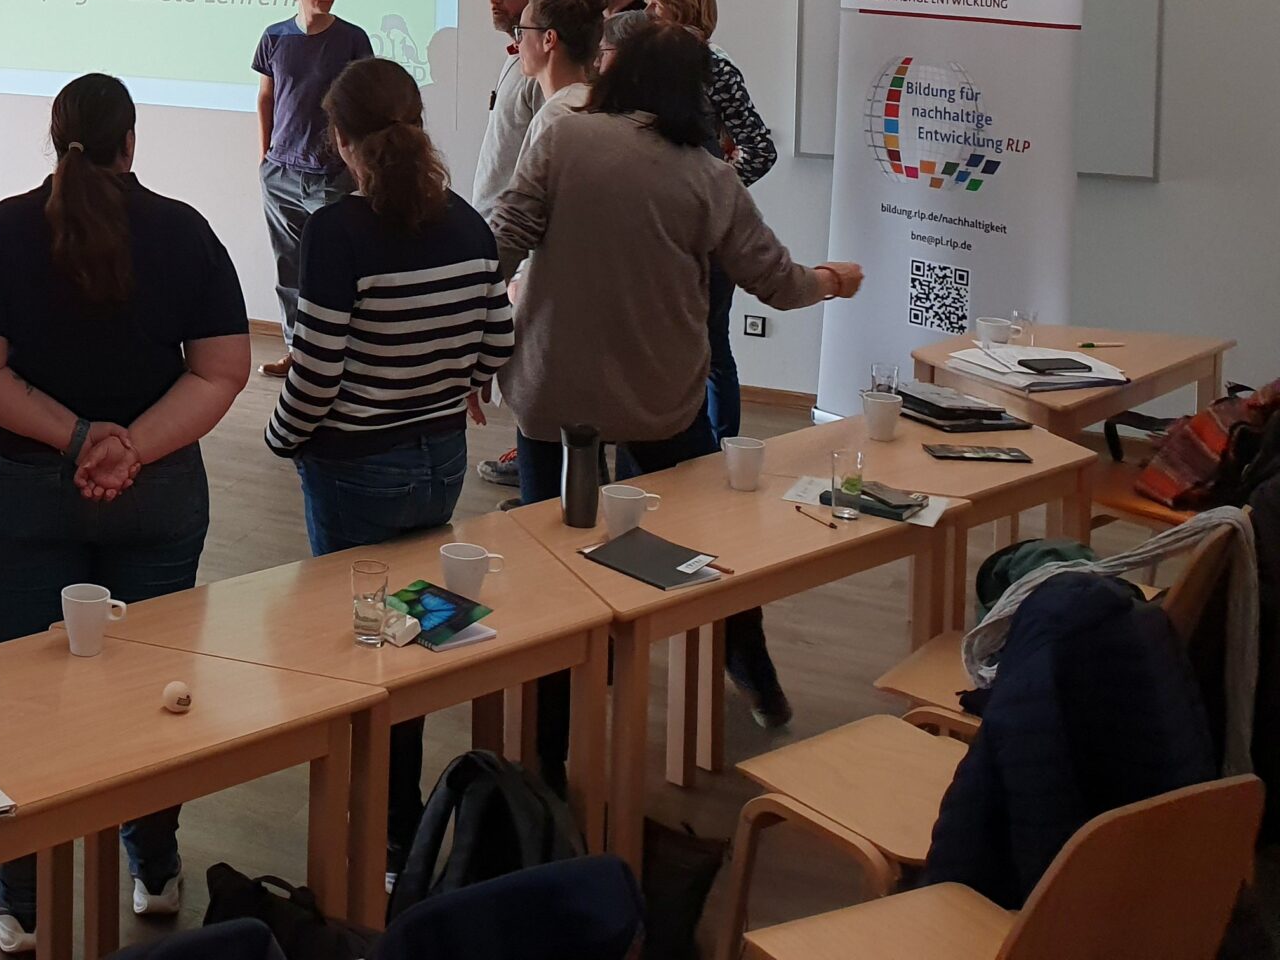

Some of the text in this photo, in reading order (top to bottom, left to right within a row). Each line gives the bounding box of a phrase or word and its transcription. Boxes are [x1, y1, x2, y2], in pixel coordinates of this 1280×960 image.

[906, 81, 981, 104] Bildung für
[911, 106, 993, 129] nachhaltige
[918, 126, 1031, 154] Entwicklung RLP
[880, 202, 1008, 235] bildung.rlp.de/nachhaltigkeit
[910, 231, 973, 251] bne@pl.rlp.de
